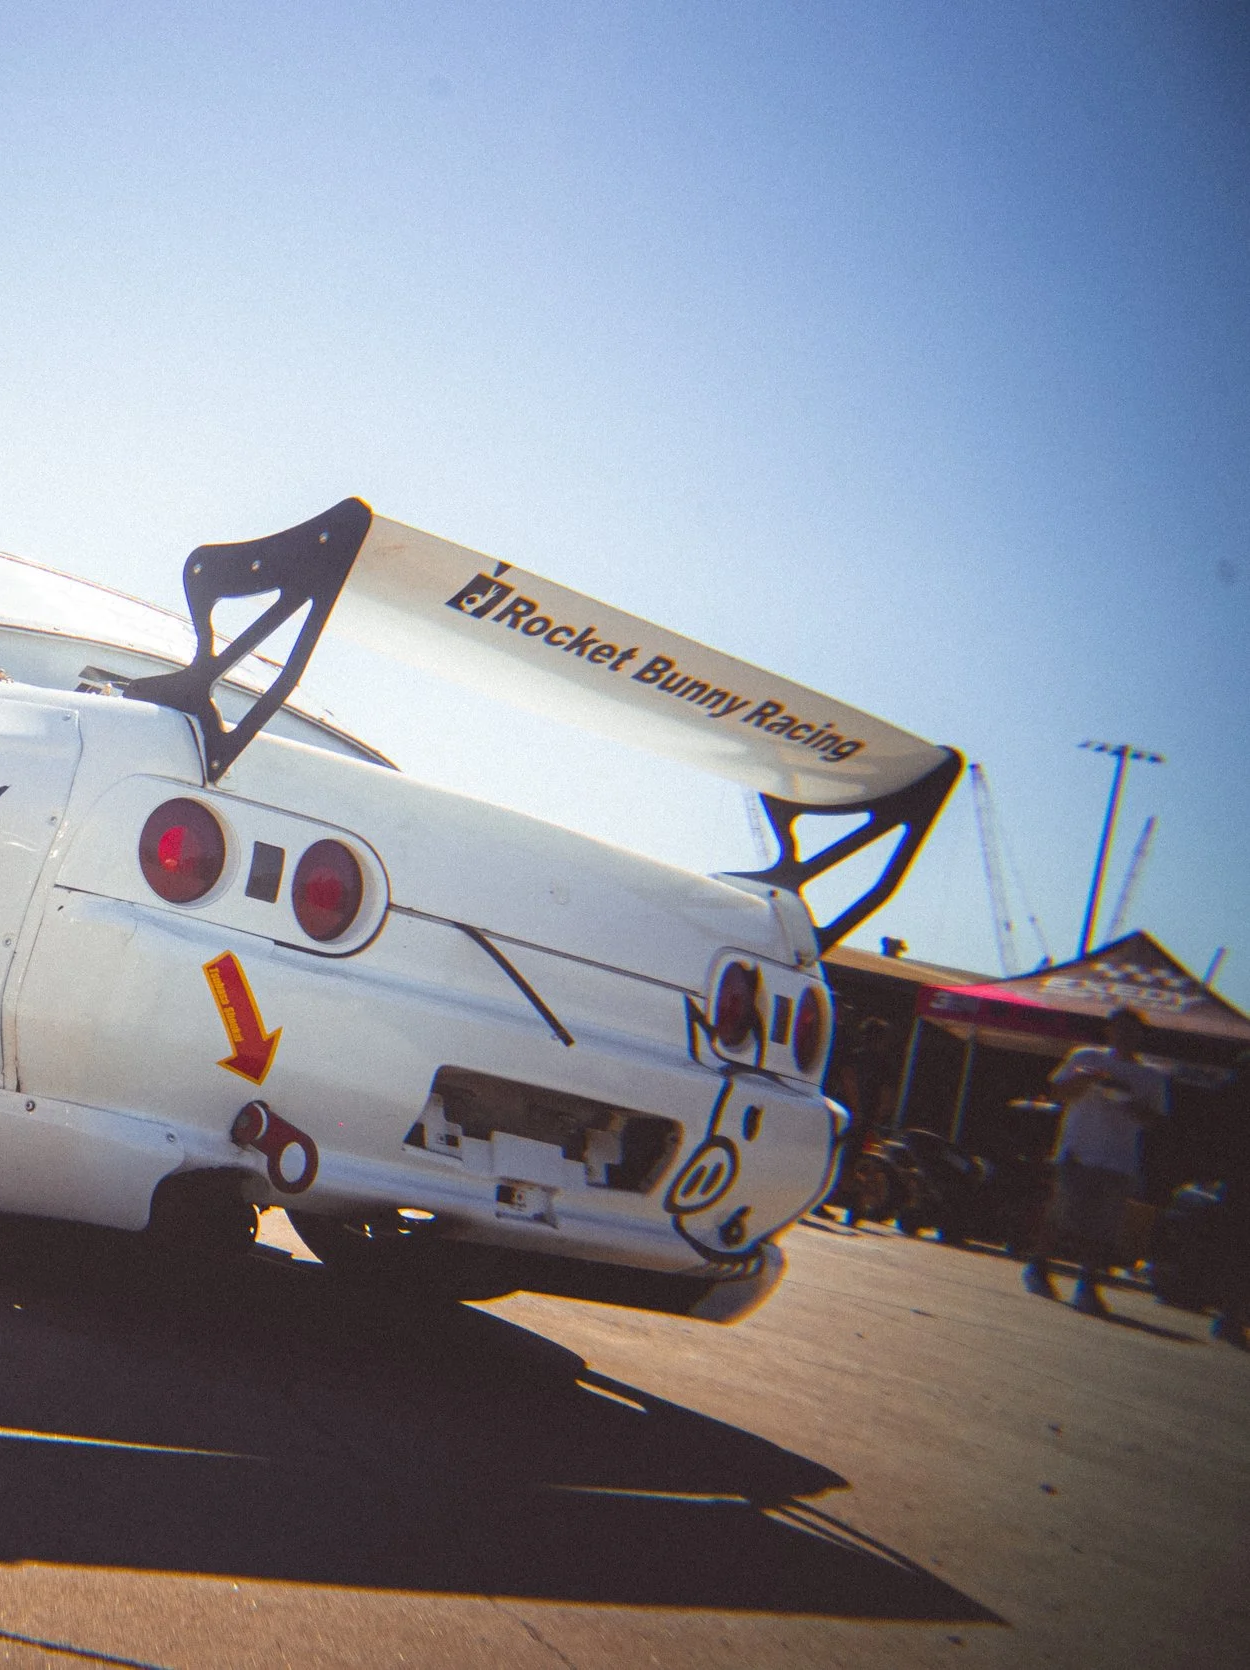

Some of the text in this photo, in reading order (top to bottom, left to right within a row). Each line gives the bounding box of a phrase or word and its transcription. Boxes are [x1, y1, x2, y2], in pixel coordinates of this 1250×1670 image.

[491, 596, 866, 762] Rocket Bunny Racing
